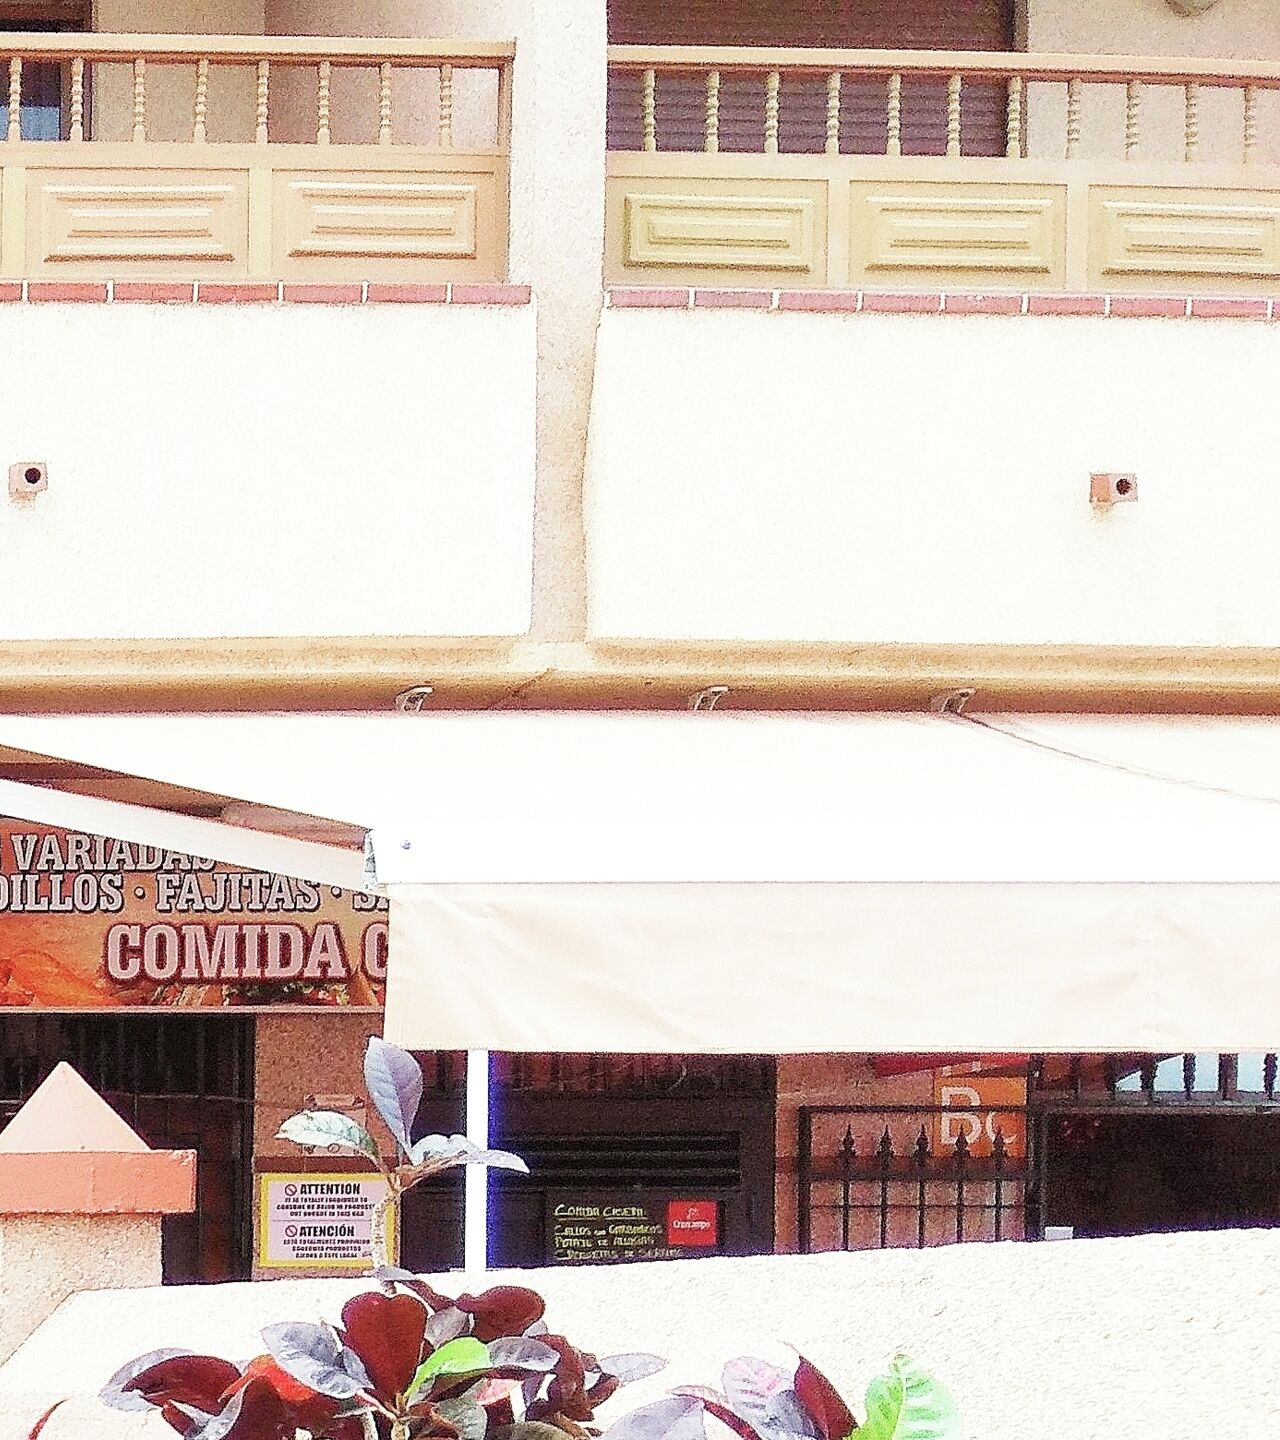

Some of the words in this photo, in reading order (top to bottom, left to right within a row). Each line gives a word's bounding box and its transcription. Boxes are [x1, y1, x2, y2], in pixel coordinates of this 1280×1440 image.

[156, 873, 320, 911] FAJITAS
[107, 923, 347, 980] COMIDA
[300, 1183, 361, 1195] ATTENTION
[300, 1224, 355, 1237] ATENCIÓN
